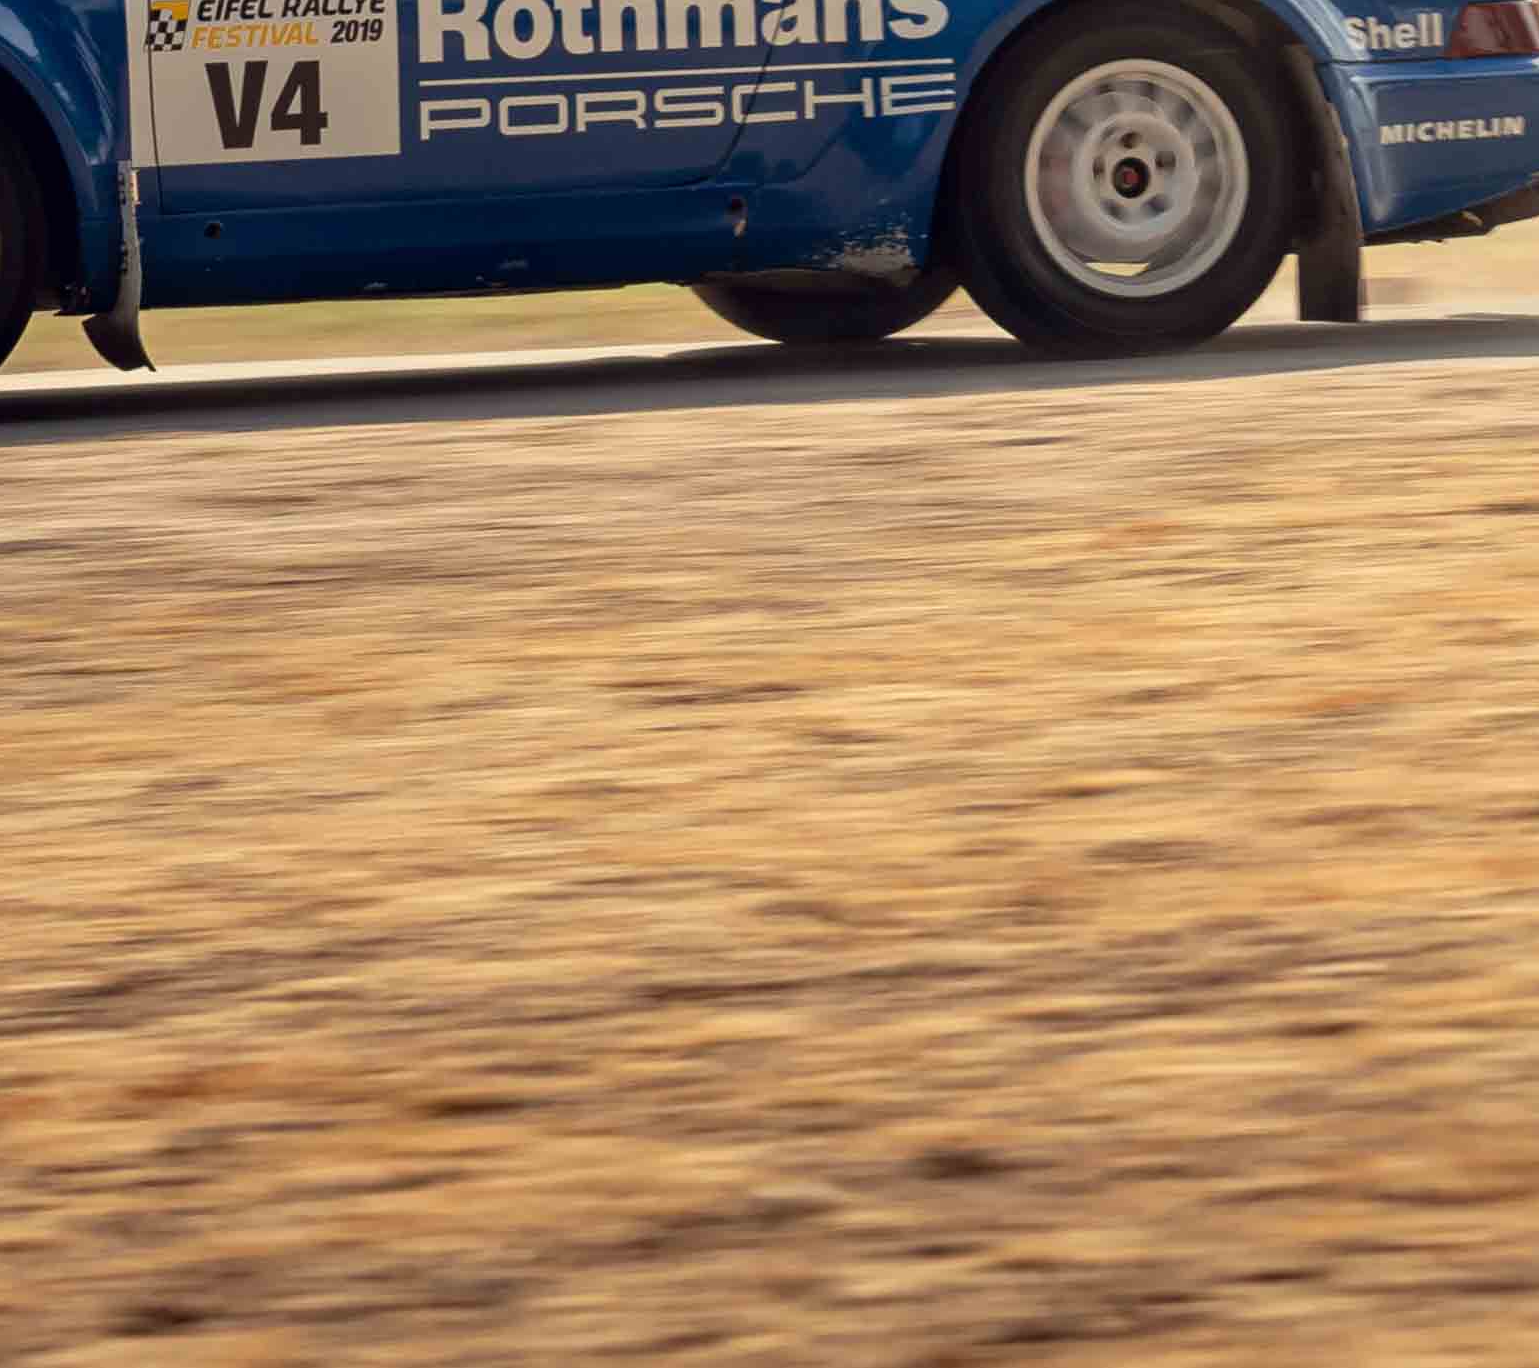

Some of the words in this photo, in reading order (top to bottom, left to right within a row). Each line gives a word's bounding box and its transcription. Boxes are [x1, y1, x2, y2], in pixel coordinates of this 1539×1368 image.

[191, 21, 320, 50] FESTIVAL
[329, 18, 384, 45] 2019
[1343, 13, 1444, 51] Shell
[204, 59, 329, 150] V4
[418, 71, 957, 141] PORSCHE
[1379, 116, 1526, 144] MICHELIN
